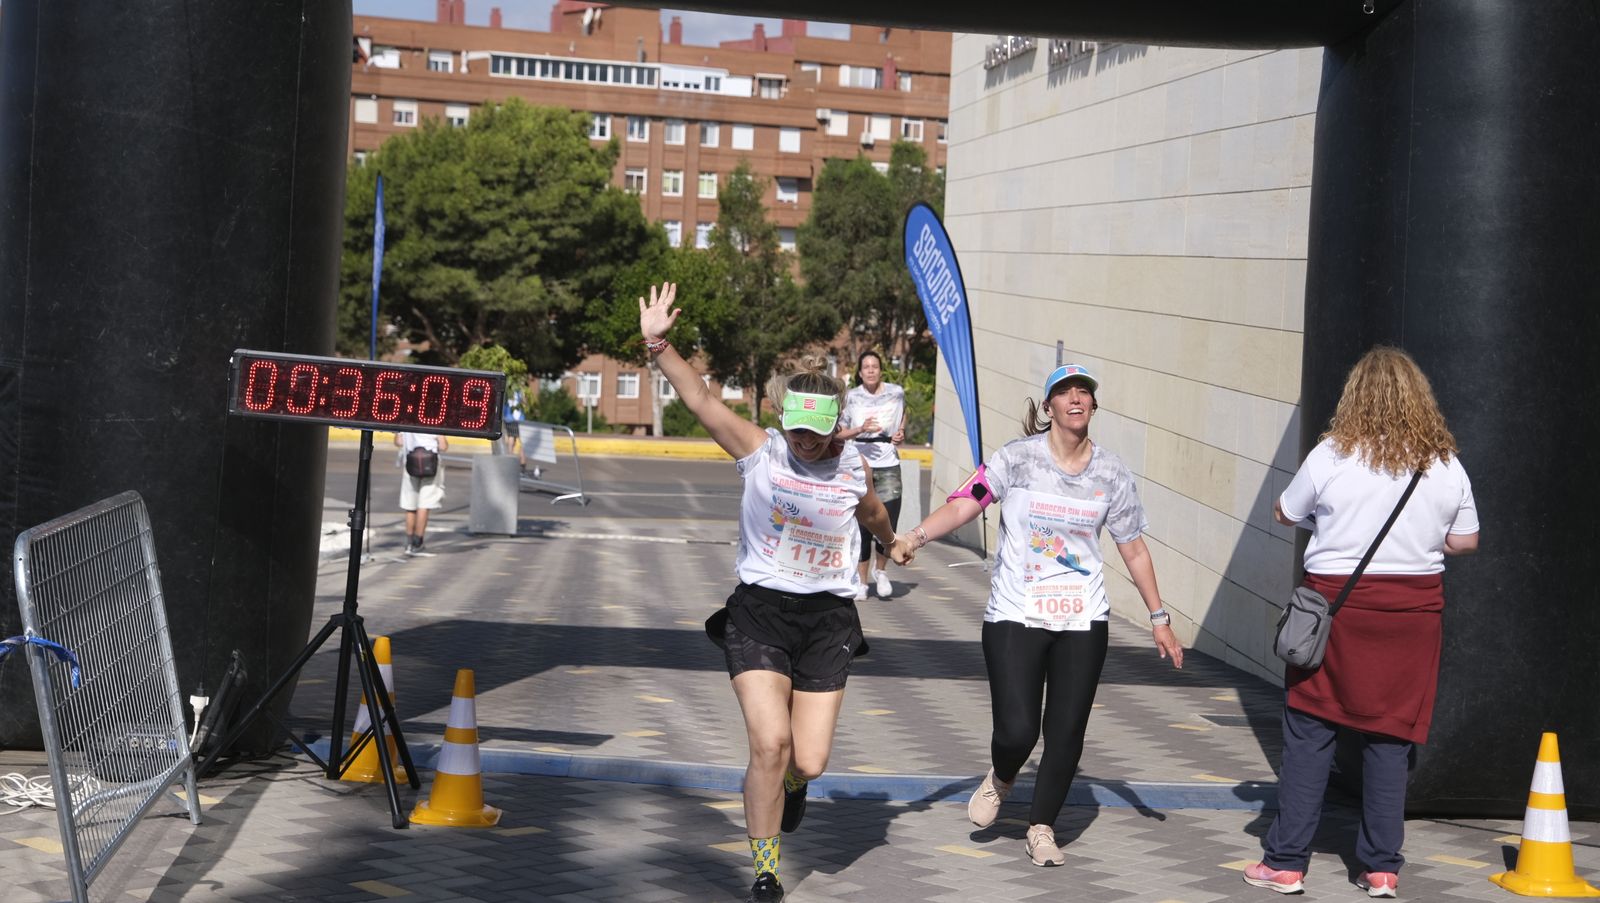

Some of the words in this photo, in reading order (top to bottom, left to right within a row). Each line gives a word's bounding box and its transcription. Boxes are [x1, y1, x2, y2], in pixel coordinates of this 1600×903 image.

[245, 360, 491, 429] 00:36:09
[790, 543, 843, 569] 1128
[1033, 597, 1084, 615] 1068
